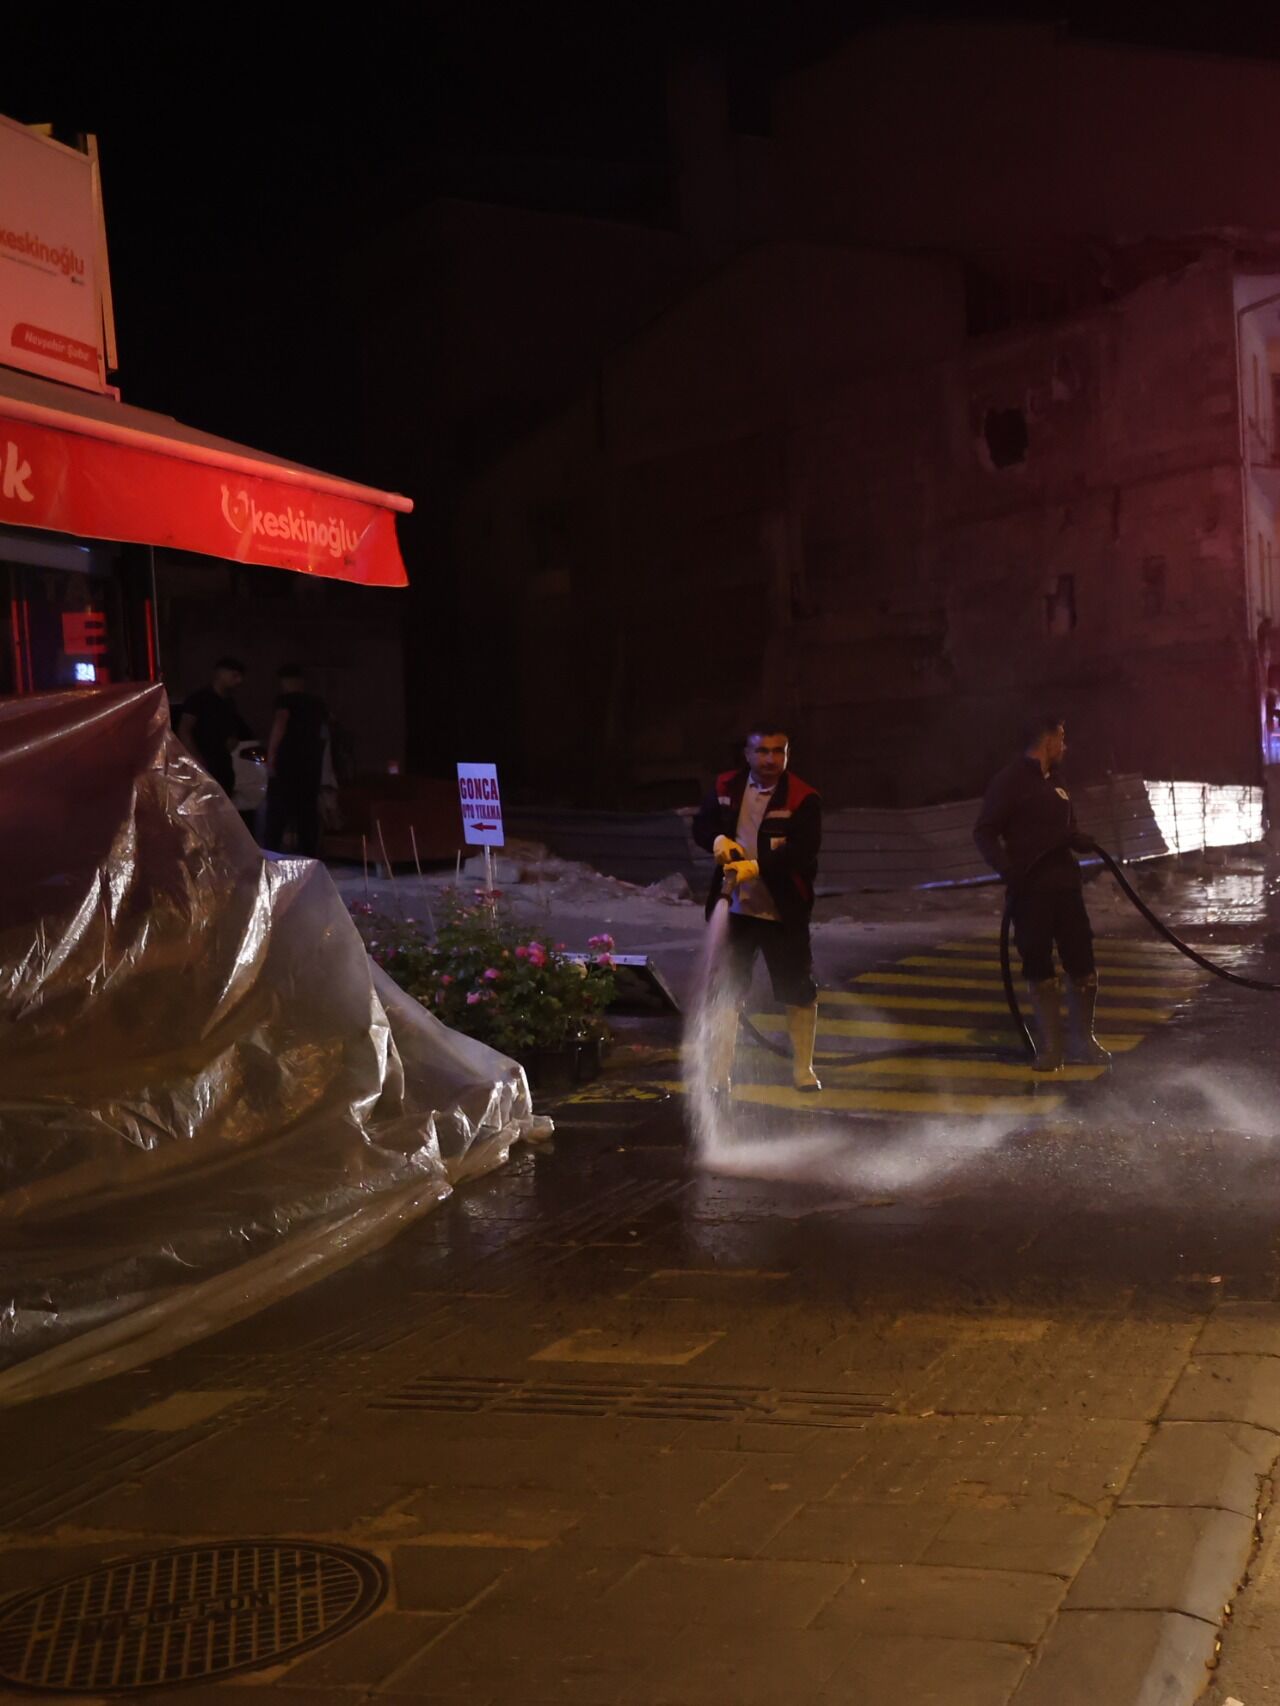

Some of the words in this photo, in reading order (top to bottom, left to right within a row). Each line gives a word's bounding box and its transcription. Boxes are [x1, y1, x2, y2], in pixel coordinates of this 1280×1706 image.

[0, 441, 34, 502] k
[251, 499, 359, 558] keskinoğlu
[460, 777, 499, 800] GONCA
